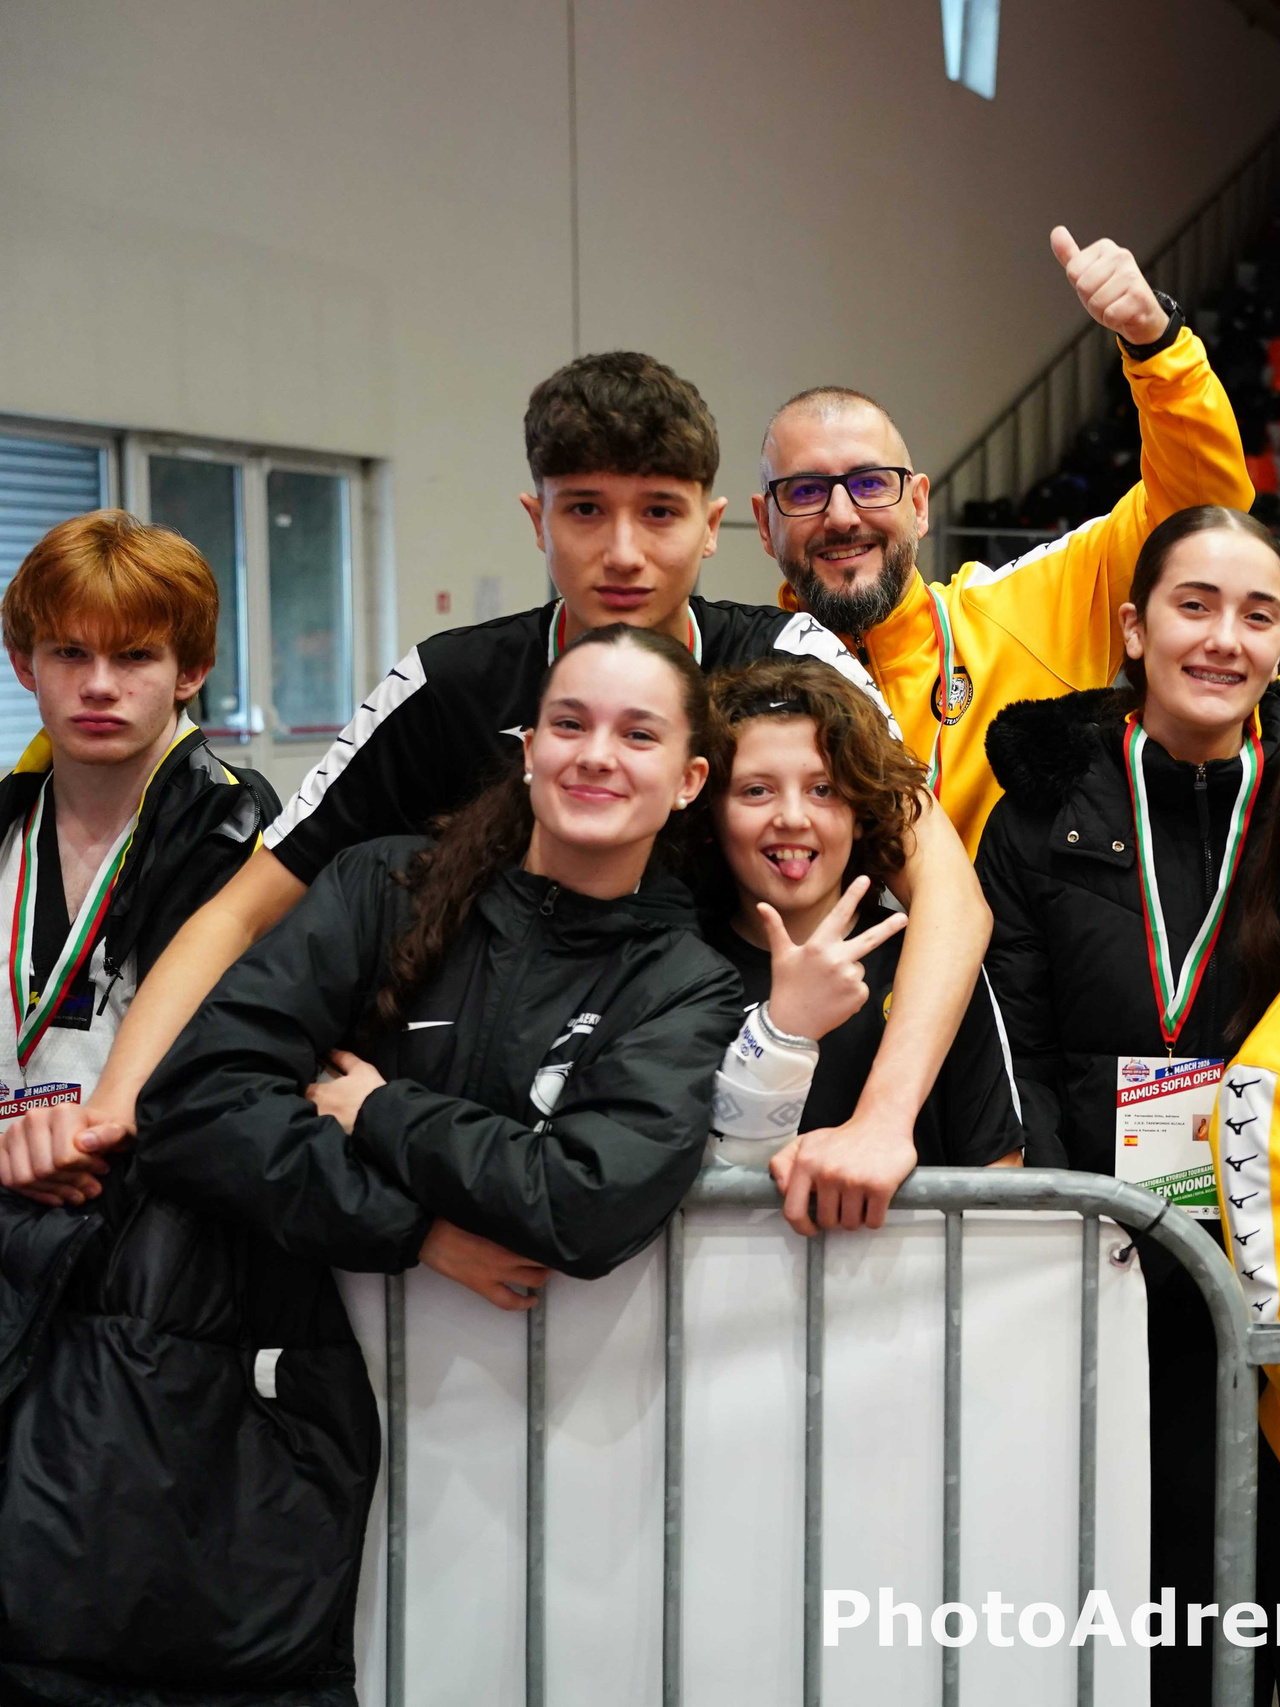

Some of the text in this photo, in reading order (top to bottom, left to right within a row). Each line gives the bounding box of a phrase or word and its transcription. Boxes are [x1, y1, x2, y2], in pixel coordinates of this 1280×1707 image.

[1174, 1062, 1197, 1074] MARCH
[1197, 1059, 1210, 1069] 2026
[33, 1084, 56, 1095] MARCH
[1121, 1068, 1221, 1103] RAMUS SOFIA OPEN
[20, 1097, 50, 1112] SOFIA
[51, 1091, 78, 1106] OPEN
